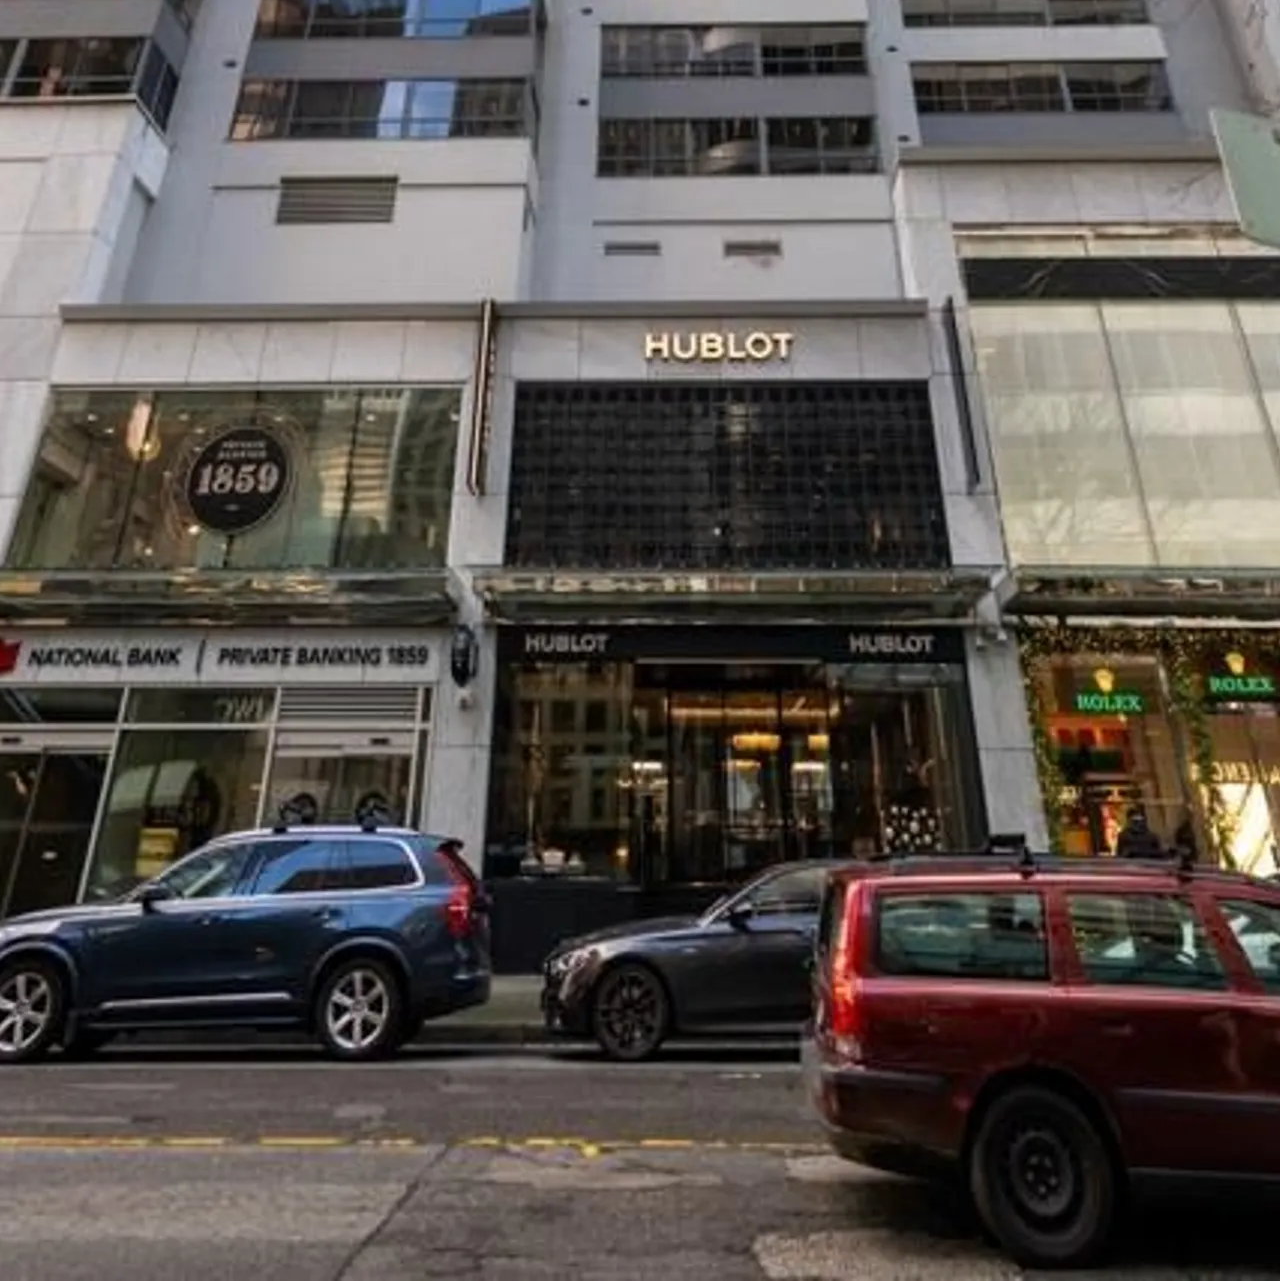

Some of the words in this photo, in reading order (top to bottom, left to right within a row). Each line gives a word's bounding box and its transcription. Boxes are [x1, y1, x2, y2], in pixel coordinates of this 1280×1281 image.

[644, 332, 795, 361] HUBLOT
[195, 462, 280, 496] 1859
[524, 633, 610, 653] HUBLOT
[849, 635, 935, 655] HUBLOT
[28, 647, 122, 667] NATIONAL
[126, 647, 182, 666] BANK
[218, 647, 293, 665] PRIVATE
[296, 647, 381, 666] BANKING
[387, 646, 429, 665] 1859
[1209, 676, 1276, 692] ROLEX
[1077, 694, 1143, 712] ROLEX
